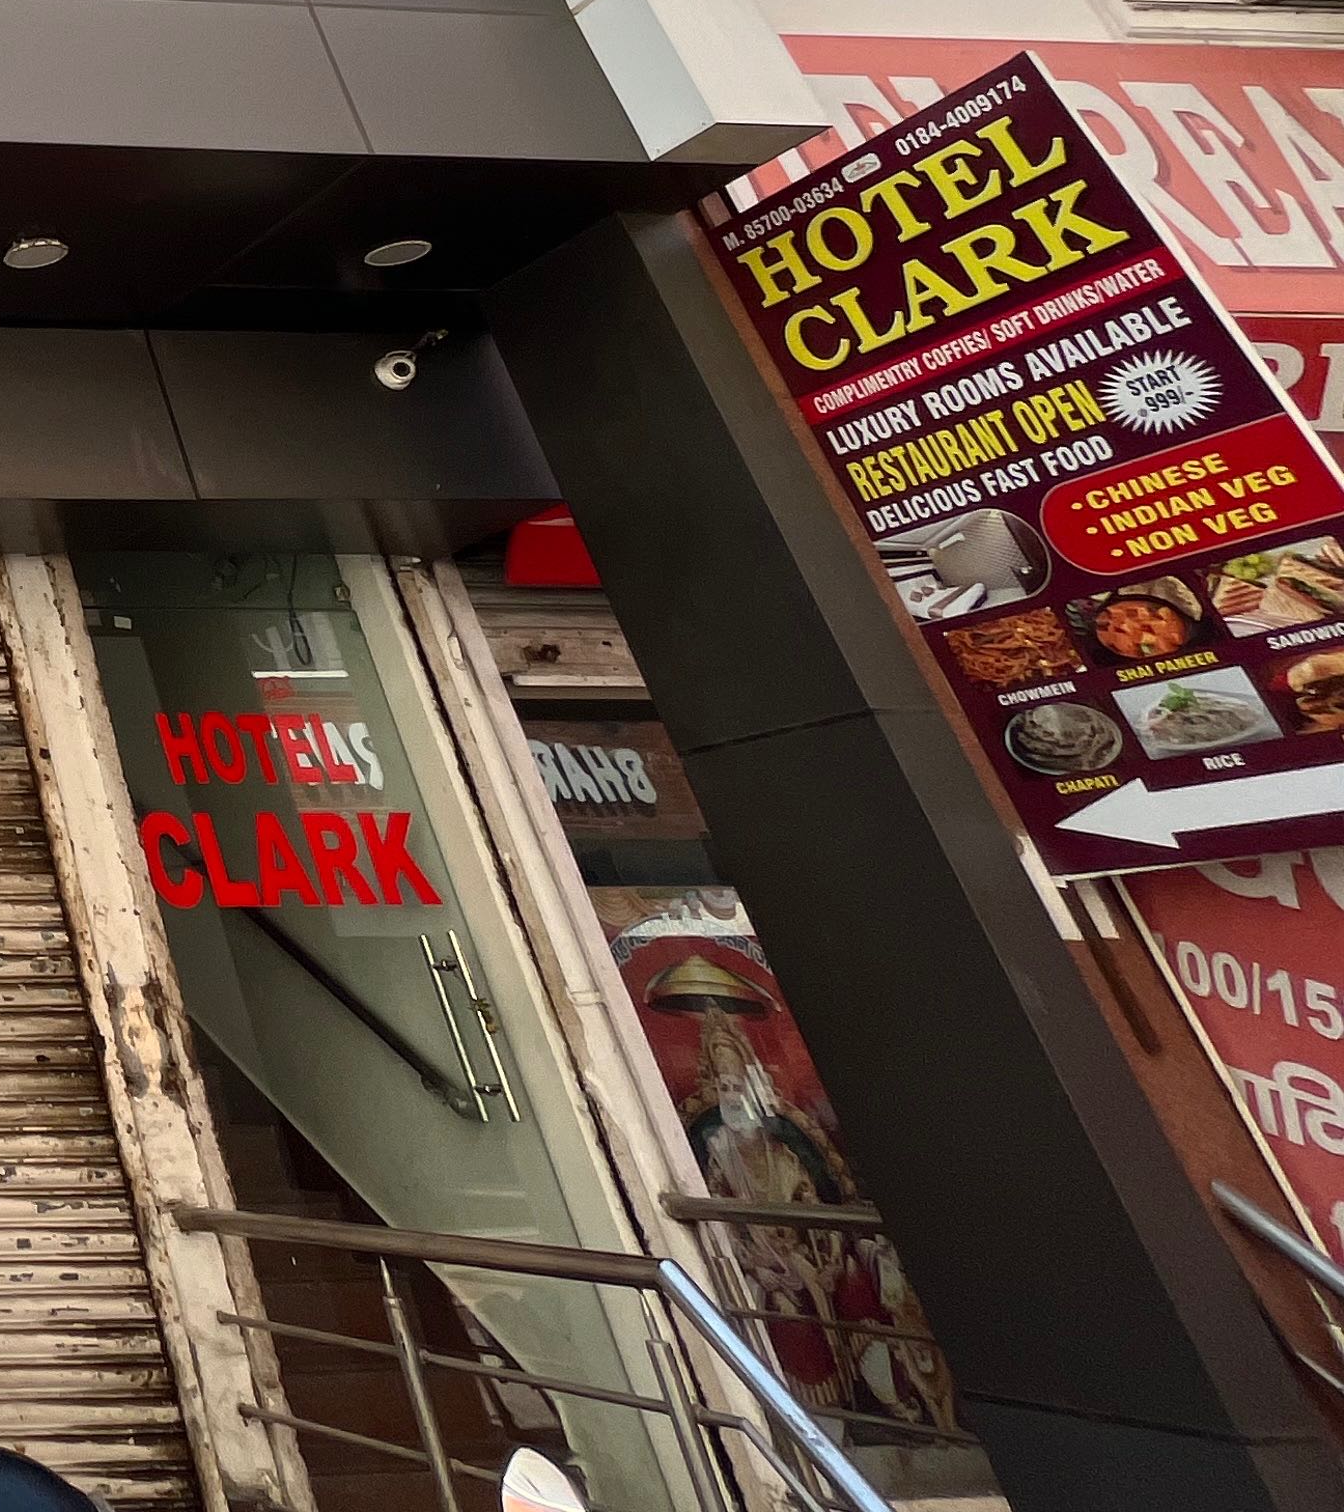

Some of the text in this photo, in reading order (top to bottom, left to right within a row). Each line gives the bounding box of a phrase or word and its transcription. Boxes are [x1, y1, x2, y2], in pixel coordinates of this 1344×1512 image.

[742, 177, 845, 241] 85700-03634
[894, 75, 1027, 157] 0184-4009174
[1052, 79, 1344, 268] REA
[737, 115, 1067, 309] HOTEL
[784, 180, 1131, 371] CLARK
[813, 359, 923, 414] COMPLIMENTRY
[990, 311, 1037, 343] SOFT
[1035, 258, 1166, 325] DRINKS/WATER
[826, 296, 1193, 455] LUXURY ROOMS AVAILABLE
[1125, 365, 1183, 397] START
[846, 379, 1108, 503] RESTAURANT OPEN
[1085, 453, 1229, 509] CHINESE
[866, 435, 1114, 533] DELICIOUS FAST FOOD
[1099, 465, 1298, 535] INDIAN VEG
[1125, 502, 1279, 558] NON VEG
[997, 681, 1077, 706] CHOWMEIN
[1156, 651, 1220, 675] PANEER
[155, 711, 359, 785] HOTEL
[1055, 774, 1120, 795] CHAPATI
[1202, 753, 1247, 771] RICE
[139, 811, 443, 908] CLARK
